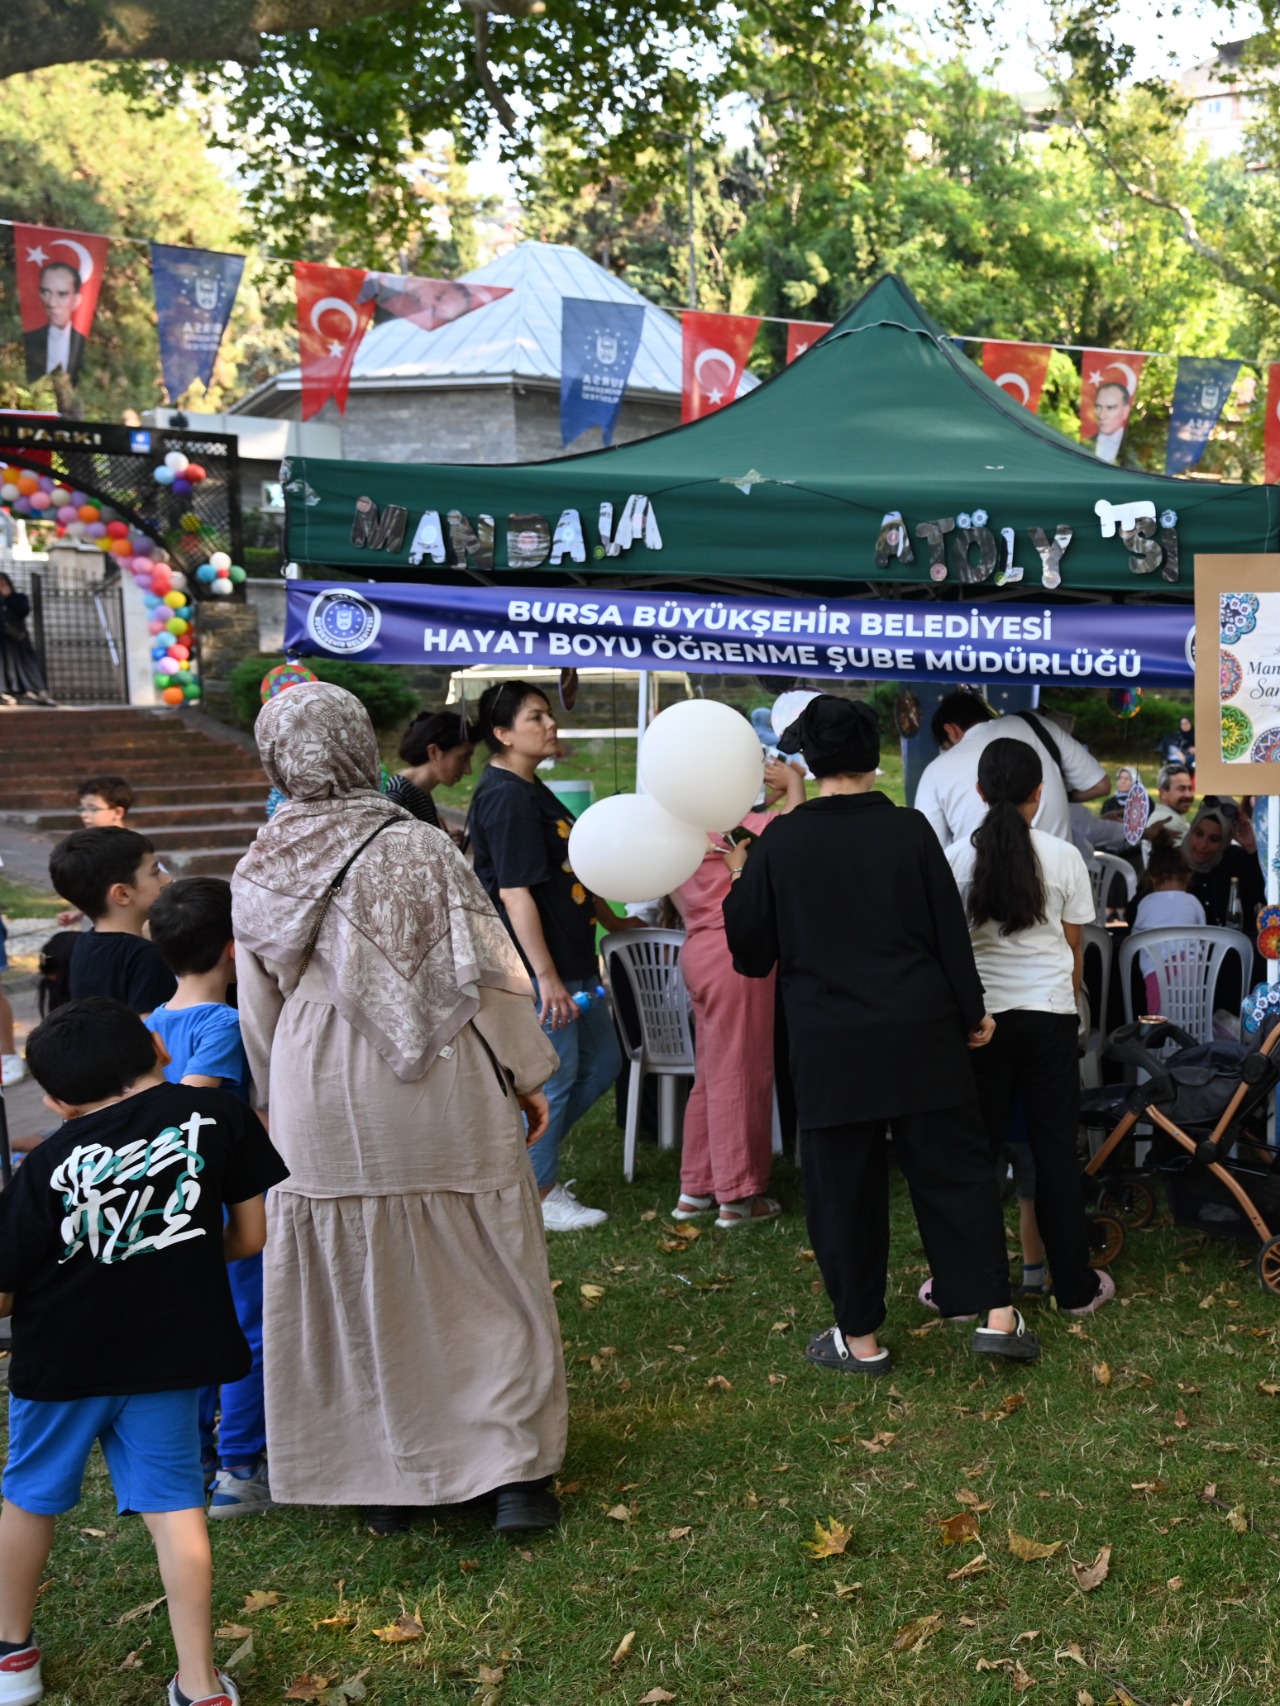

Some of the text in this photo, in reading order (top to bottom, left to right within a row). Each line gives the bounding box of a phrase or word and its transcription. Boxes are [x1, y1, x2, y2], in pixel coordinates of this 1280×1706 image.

[351, 494, 663, 571] MANDALA
[507, 600, 1052, 641] BURSA BÜYÜKŞEHİR BELEDİYESİ
[423, 628, 1142, 678] HAYAT BOYU ÖĞRENME ŞUBE MÜDÜRLÜĞÜ
